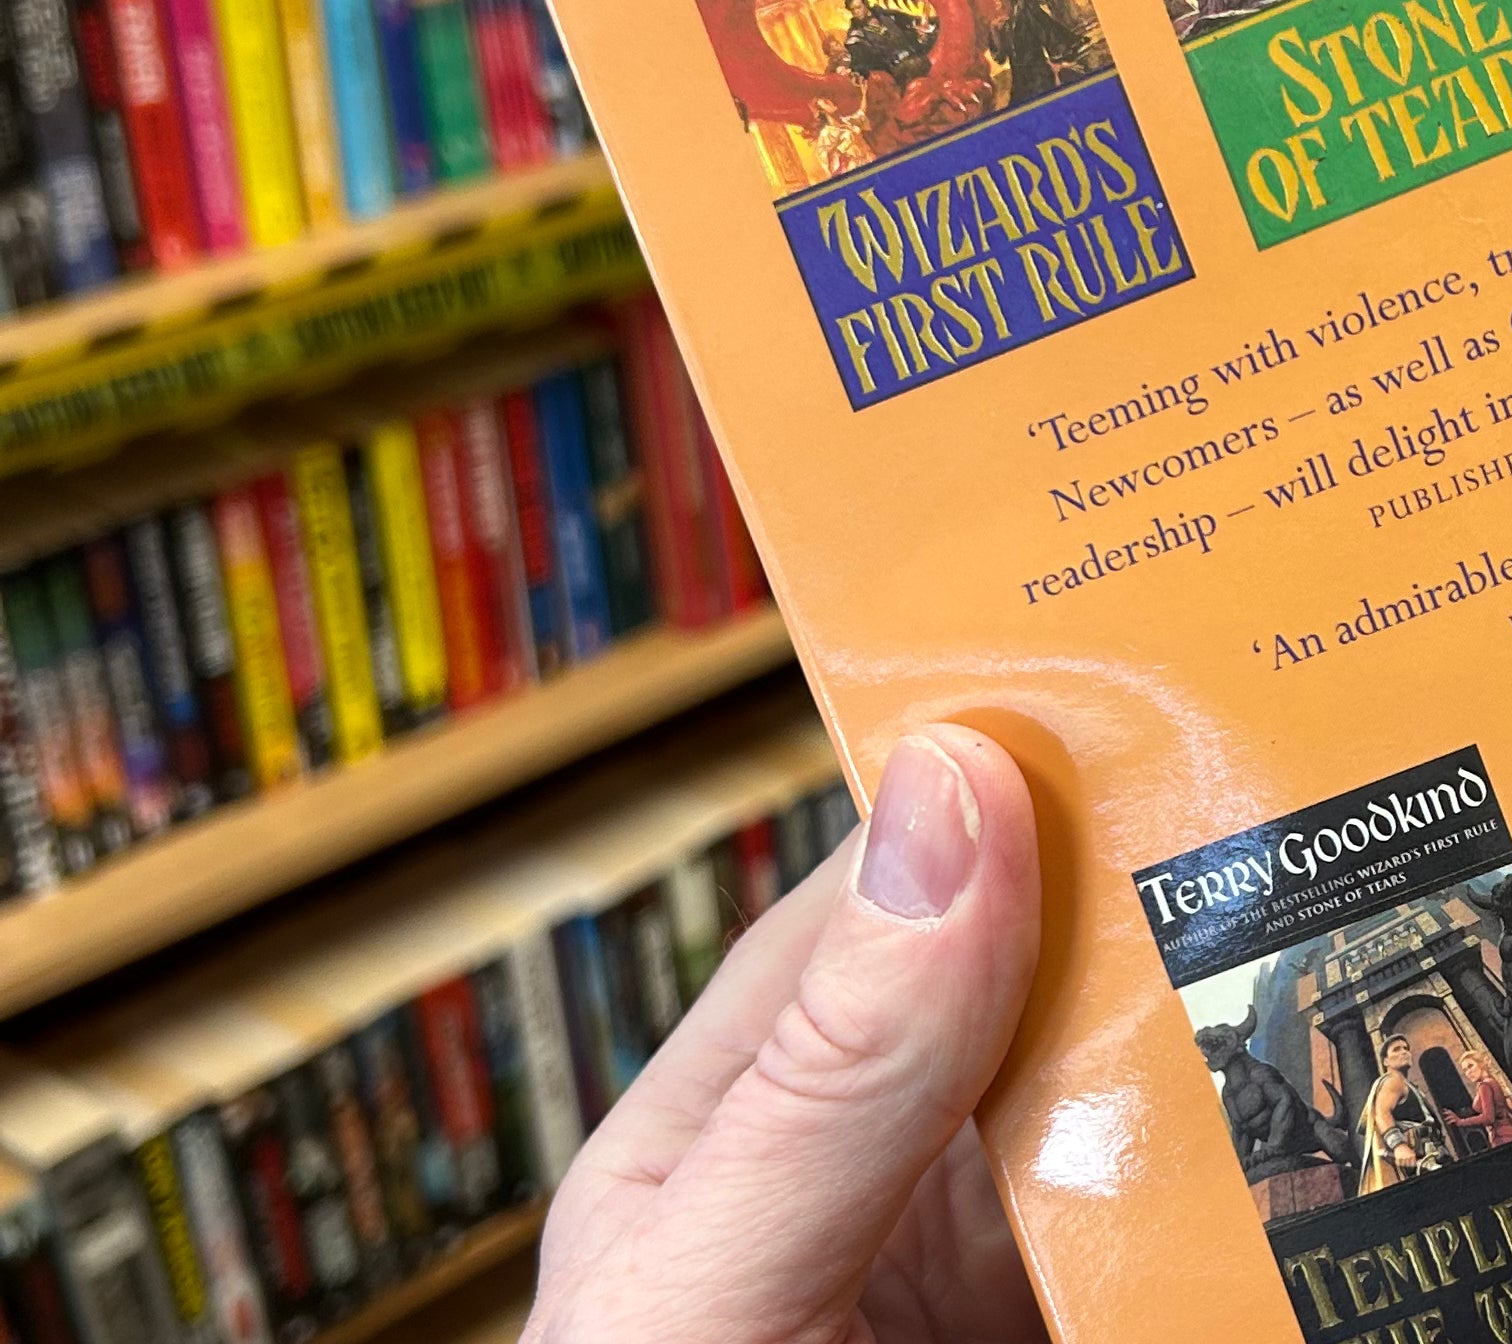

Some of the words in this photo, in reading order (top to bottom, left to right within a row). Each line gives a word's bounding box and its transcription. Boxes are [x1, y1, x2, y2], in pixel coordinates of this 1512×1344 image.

[816, 119, 1138, 293] WIZARD'S
[1245, 130, 1328, 224] OF
[836, 259, 1012, 394] FIRST
[1015, 196, 1182, 322] RULE
[1210, 327, 1298, 387] with
[1307, 268, 1481, 349] violence,
[1047, 413, 1280, 523] Newcomers
[1326, 381, 1364, 416] as
[1371, 334, 1454, 395] well
[1463, 328, 1502, 362] as
[1021, 510, 1217, 604] readership
[1264, 453, 1338, 511] will
[1348, 404, 1480, 479] delight
[1163, 927, 1218, 952] AUTHOR
[1241, 907, 1268, 923] THE
[1271, 873, 1355, 913] BESTSELLING
[1357, 848, 1421, 879] WIZARD'S
[1424, 833, 1460, 855] FIRST
[1463, 818, 1498, 840] RULE
[1265, 914, 1294, 936] AND
[1299, 896, 1342, 921] STONE
[1345, 888, 1364, 902] OF
[1365, 872, 1407, 895] TEARS
